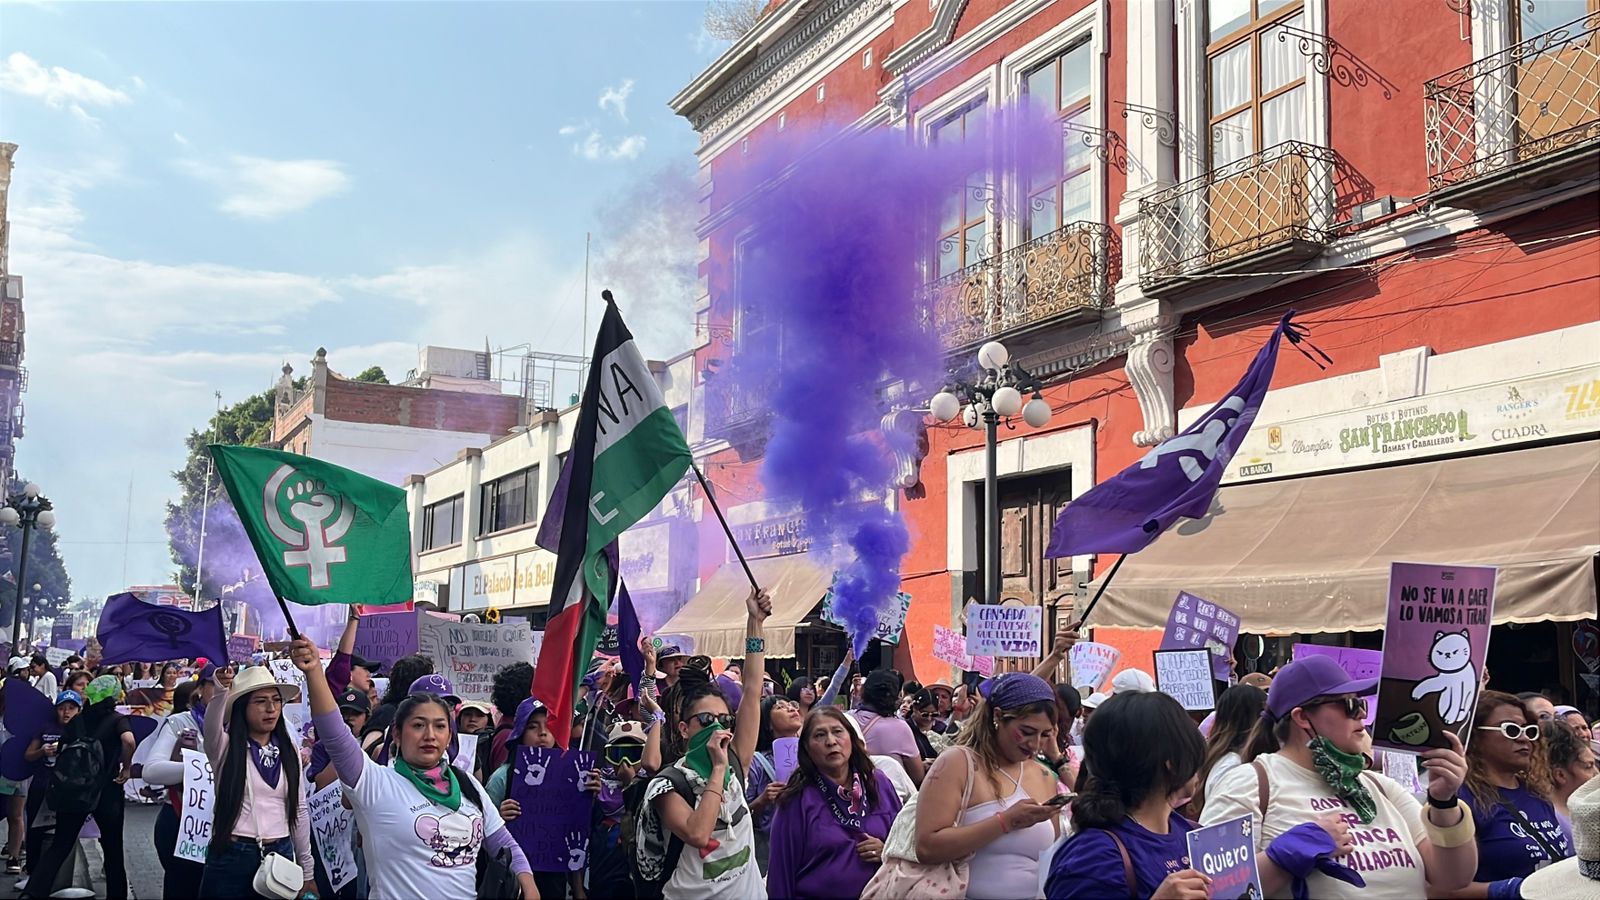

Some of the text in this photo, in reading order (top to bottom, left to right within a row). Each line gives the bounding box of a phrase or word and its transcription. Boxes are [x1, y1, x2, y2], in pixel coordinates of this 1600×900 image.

[1366, 412, 1389, 426] BOTAS
[1398, 405, 1429, 420] BOTINES
[1496, 399, 1539, 413] RANGER'S
[1340, 411, 1457, 454] SAN FRANCISCO
[1491, 423, 1549, 442] CUADRA
[1291, 438, 1334, 457] Wrangler
[1381, 444, 1406, 454] DAMAS
[1412, 436, 1455, 449] CABALLEROS
[1240, 466, 1250, 476] LA
[1250, 463, 1272, 475] BARCA
[473, 575, 482, 596] El
[483, 571, 511, 595] Palacio
[524, 566, 533, 589] la
[1401, 586, 1488, 607] NO SE VA A CAER
[979, 608, 1027, 621] CANSADA
[1400, 604, 1488, 626] LO VAMOS A TIRAR
[976, 630, 1032, 640] QUE LLEGUE
[984, 620, 1032, 631] DE AVISAR
[981, 639, 1038, 652] CON VIDA
[188, 787, 208, 811] DE
[308, 798, 320, 814] NO
[184, 815, 212, 843] QUE
[1202, 844, 1249, 875] Quiero
